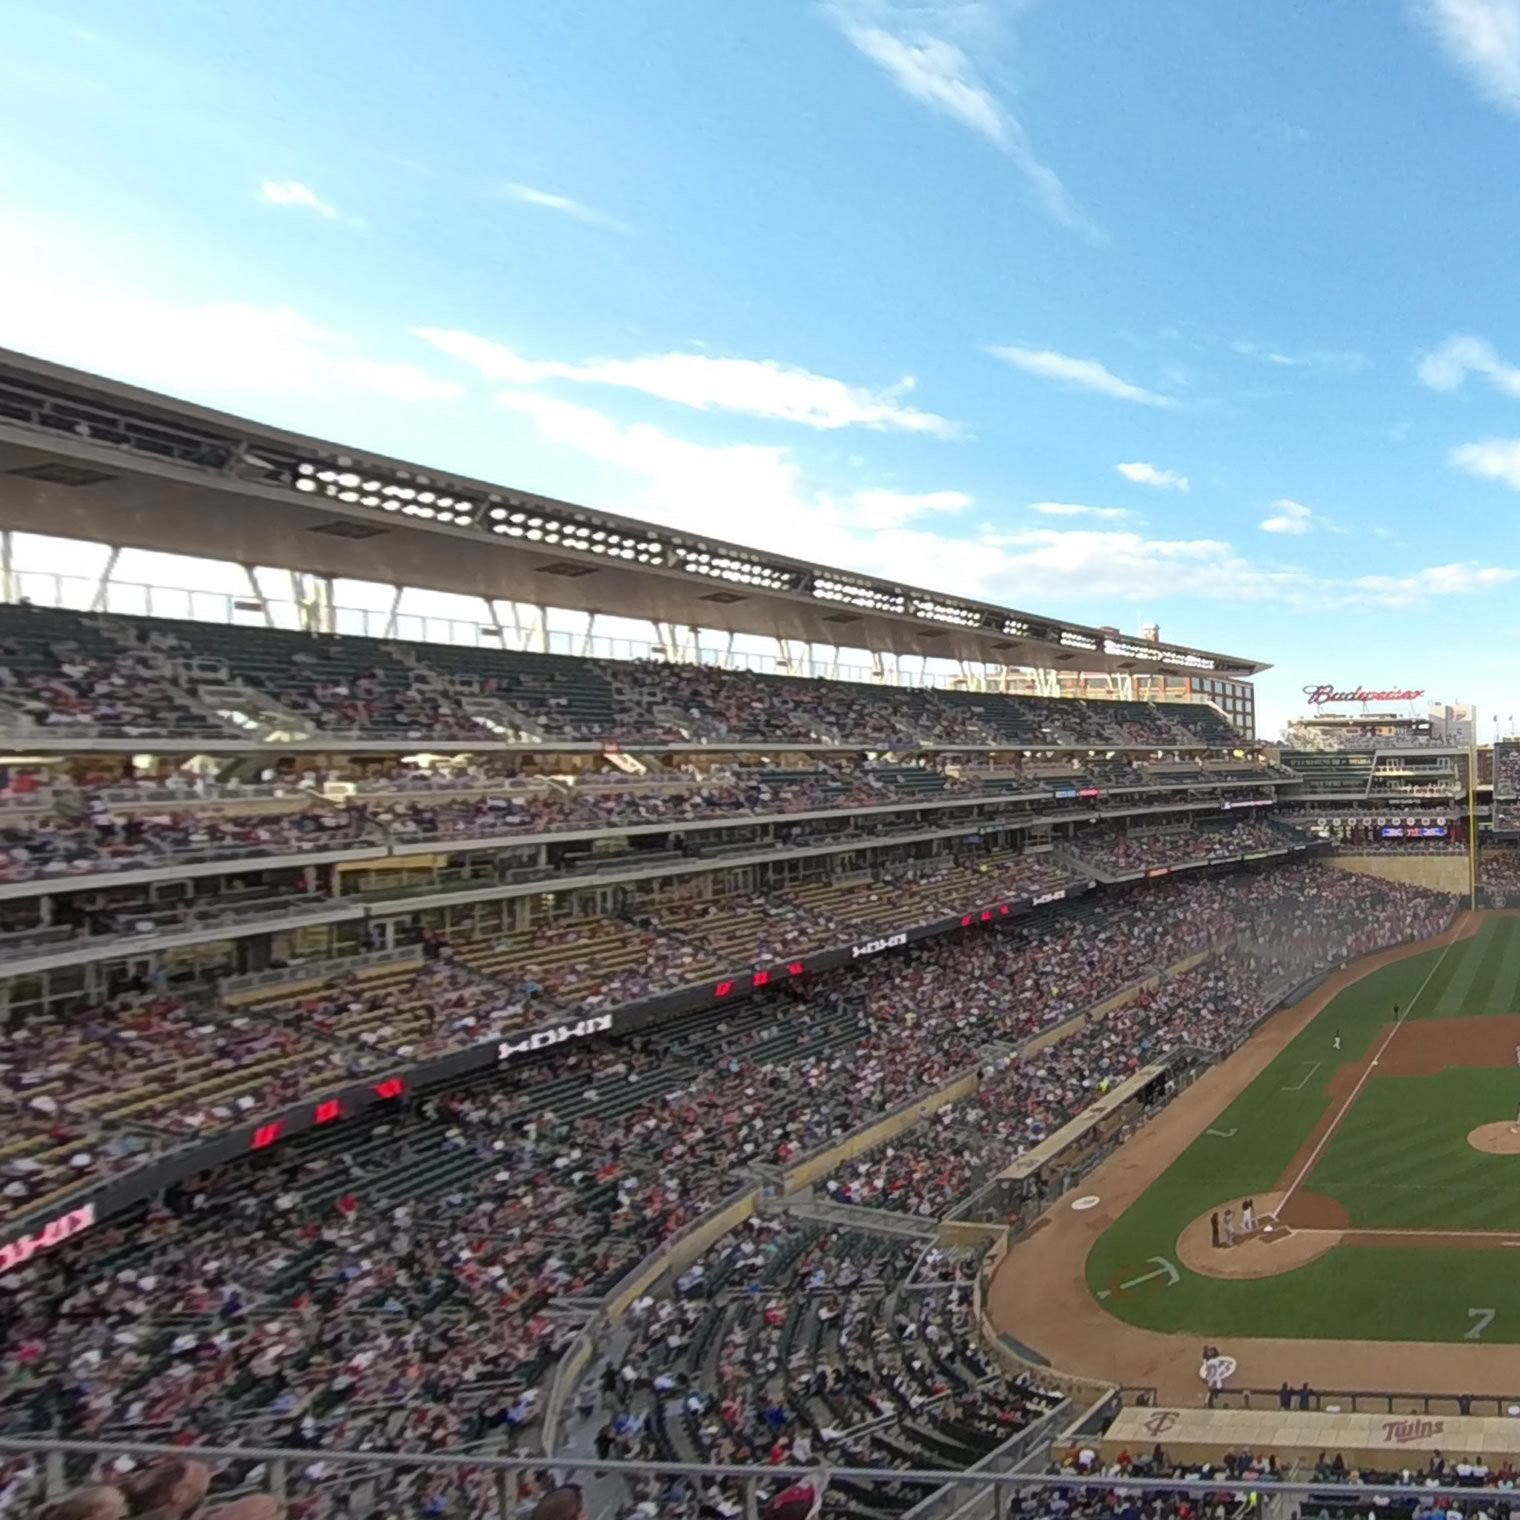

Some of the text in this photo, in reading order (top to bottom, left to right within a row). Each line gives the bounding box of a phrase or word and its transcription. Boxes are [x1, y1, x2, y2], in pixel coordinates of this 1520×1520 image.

[1303, 684, 1424, 705] Budweiser
[1463, 1307, 1496, 1340] 7
[1381, 1419, 1445, 1444] Twins
